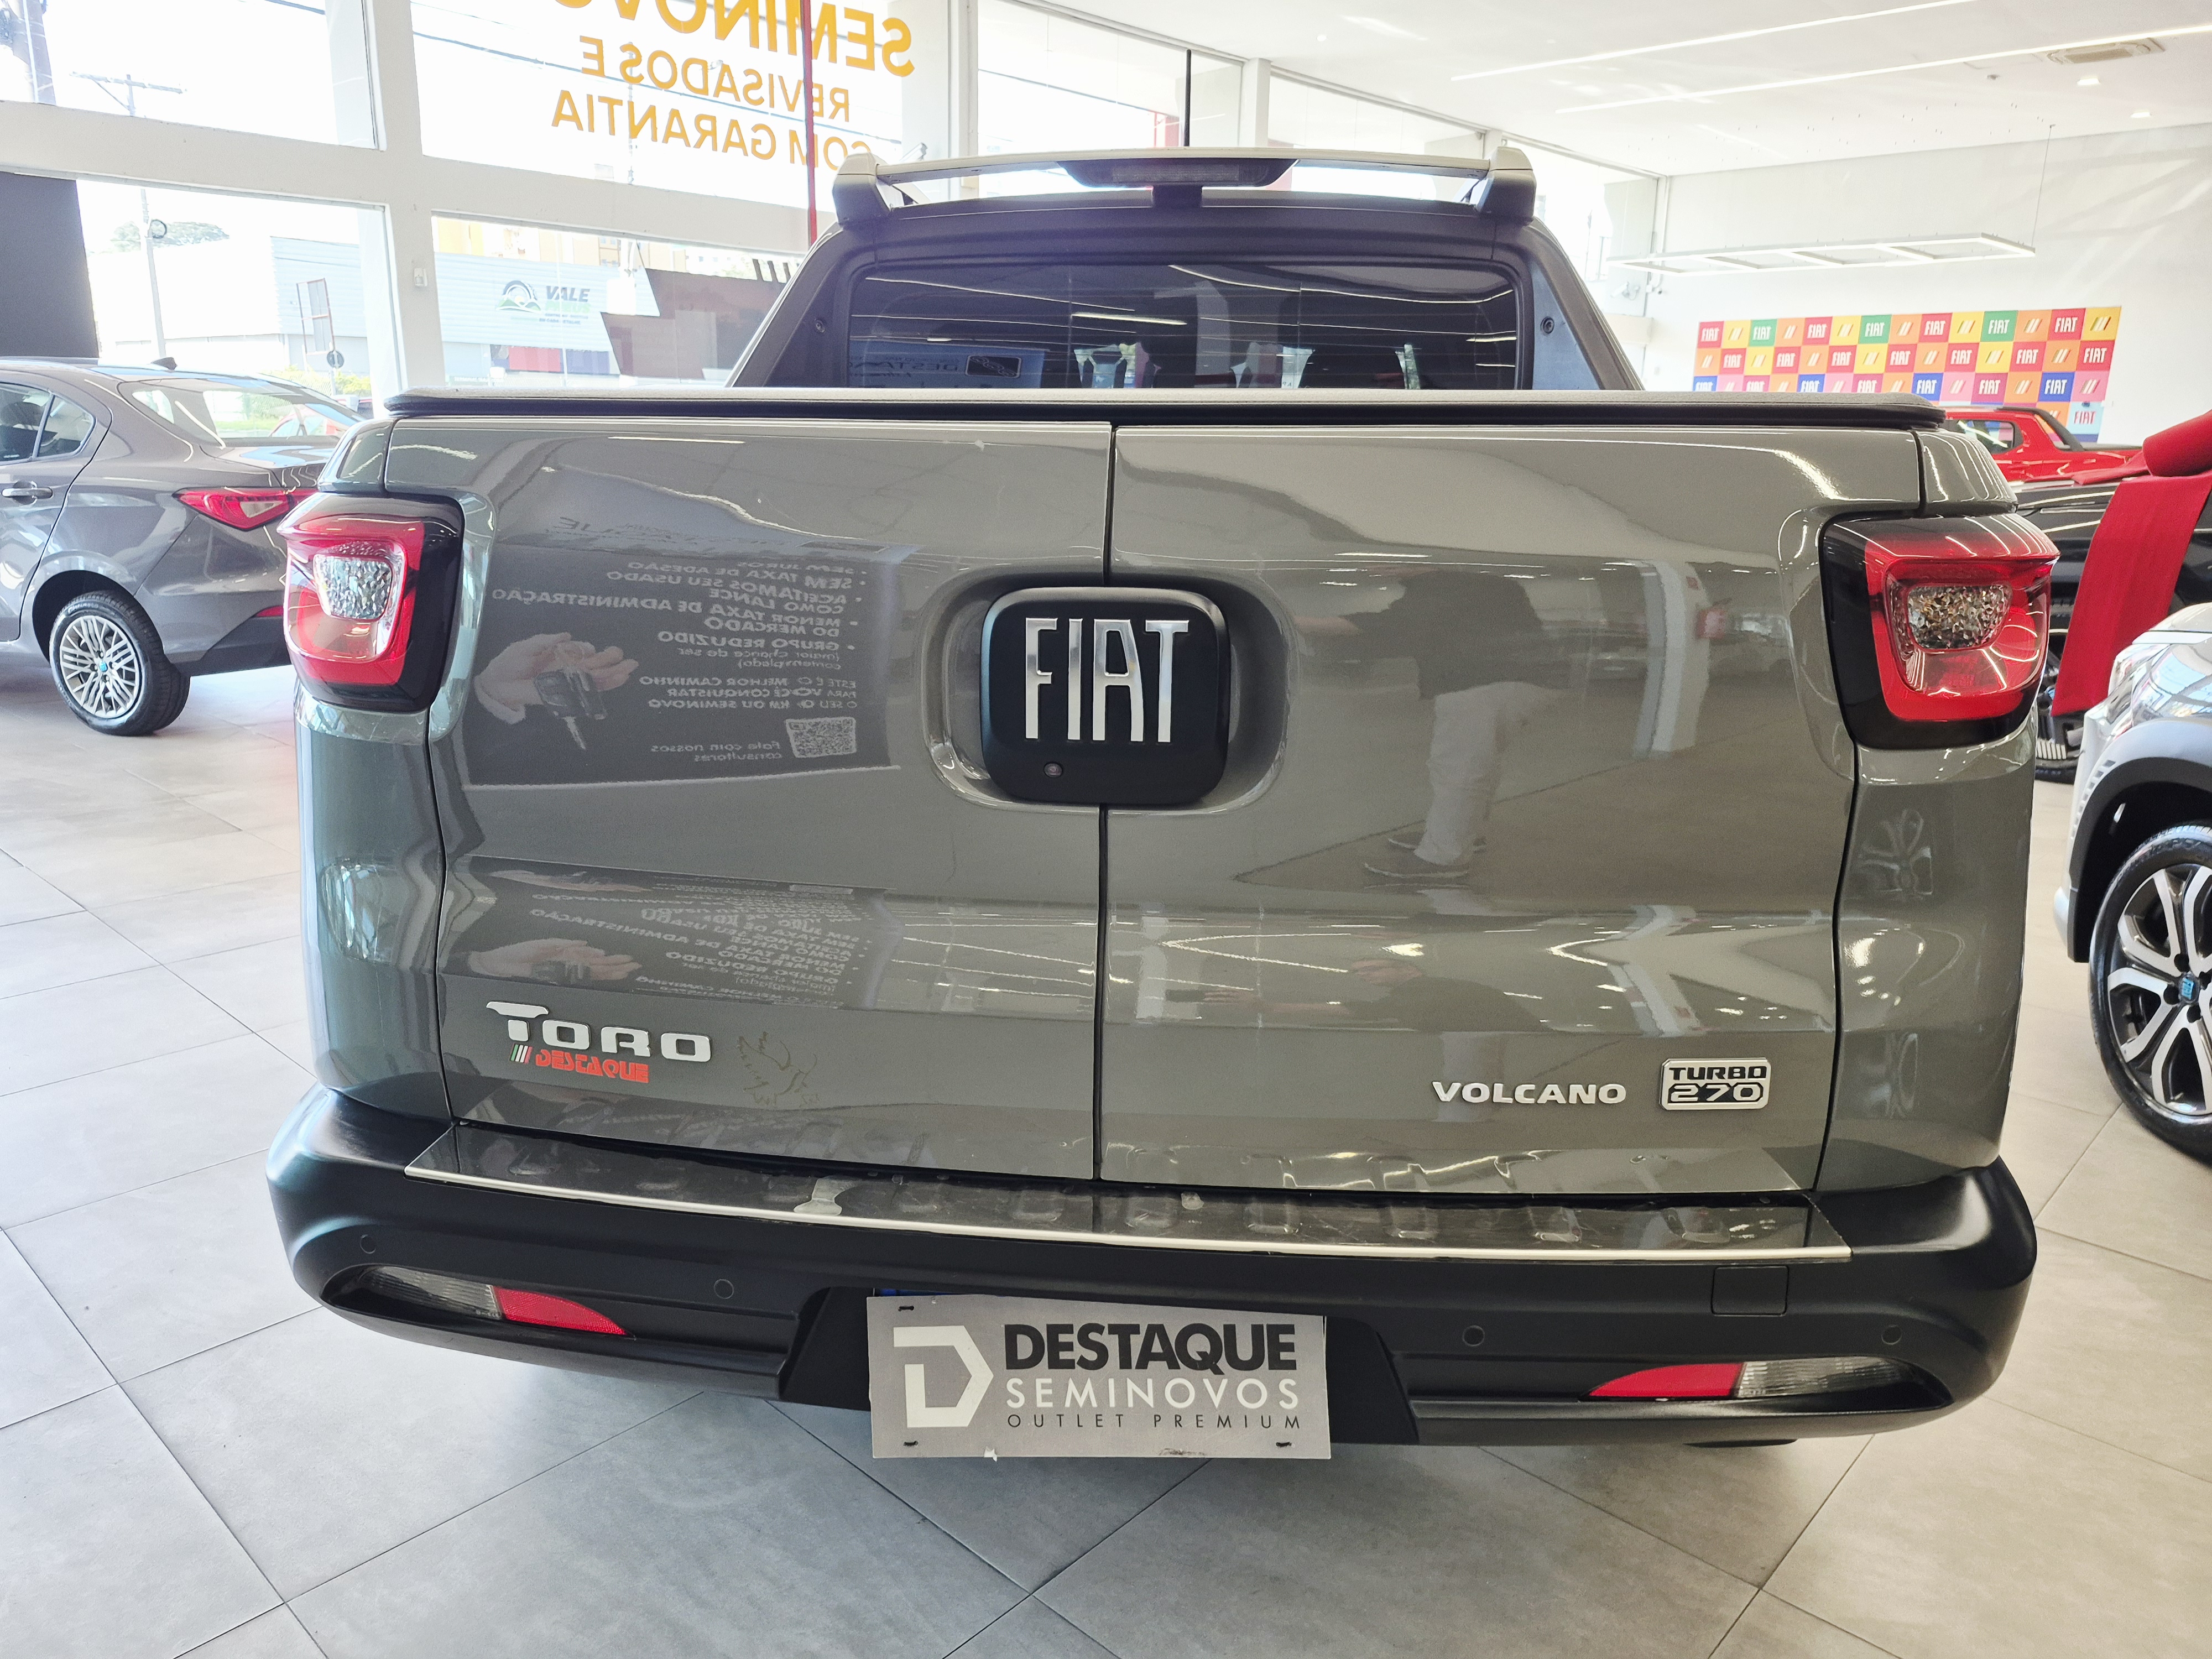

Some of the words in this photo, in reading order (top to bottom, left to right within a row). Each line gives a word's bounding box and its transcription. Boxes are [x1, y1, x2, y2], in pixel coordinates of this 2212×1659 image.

[546, 285, 590, 302] VALE
[1807, 324, 1828, 338] FIAT
[1865, 322, 1885, 337] FIAT
[1924, 320, 1945, 336] FIAT
[1988, 319, 2010, 335] FIAT
[2054, 317, 2078, 332] FIAT
[1700, 327, 1719, 342] FIAT
[1752, 326, 1772, 340] FIAT
[1723, 353, 1742, 368] FIAT
[1776, 352, 1796, 367] FIAT
[1832, 351, 1852, 366] FIAT
[1889, 351, 1911, 365] FIAT
[1950, 349, 1972, 365] FIAT
[2016, 349, 2039, 364] FIAT
[2083, 348, 2107, 363] FIAT
[1695, 382, 1713, 392] FIAT
[1746, 381, 1765, 392] FIAT
[1801, 380, 1820, 393] FIAT
[1856, 379, 1877, 393] FIAT
[1916, 379, 1937, 394] FIAT
[1979, 379, 2001, 395] FIAT
[2044, 379, 2068, 395] FIAT
[2074, 411, 2095, 425] FIAT
[1025, 617, 1190, 743] FIAT
[486, 1001, 713, 1063] TORO
[535, 1049, 649, 1083] DESTAQUE
[1668, 1066, 1767, 1081] TURBO
[1432, 1081, 1627, 1104] VOLCANO
[1670, 1083, 1764, 1103] 270
[1004, 1323, 1297, 1375] DESTAQUE
[1006, 1378, 1299, 1410] SEMINOVOS
[1008, 1413, 1124, 1428] OUTLET
[1154, 1414, 1301, 1430] PREMIUM
